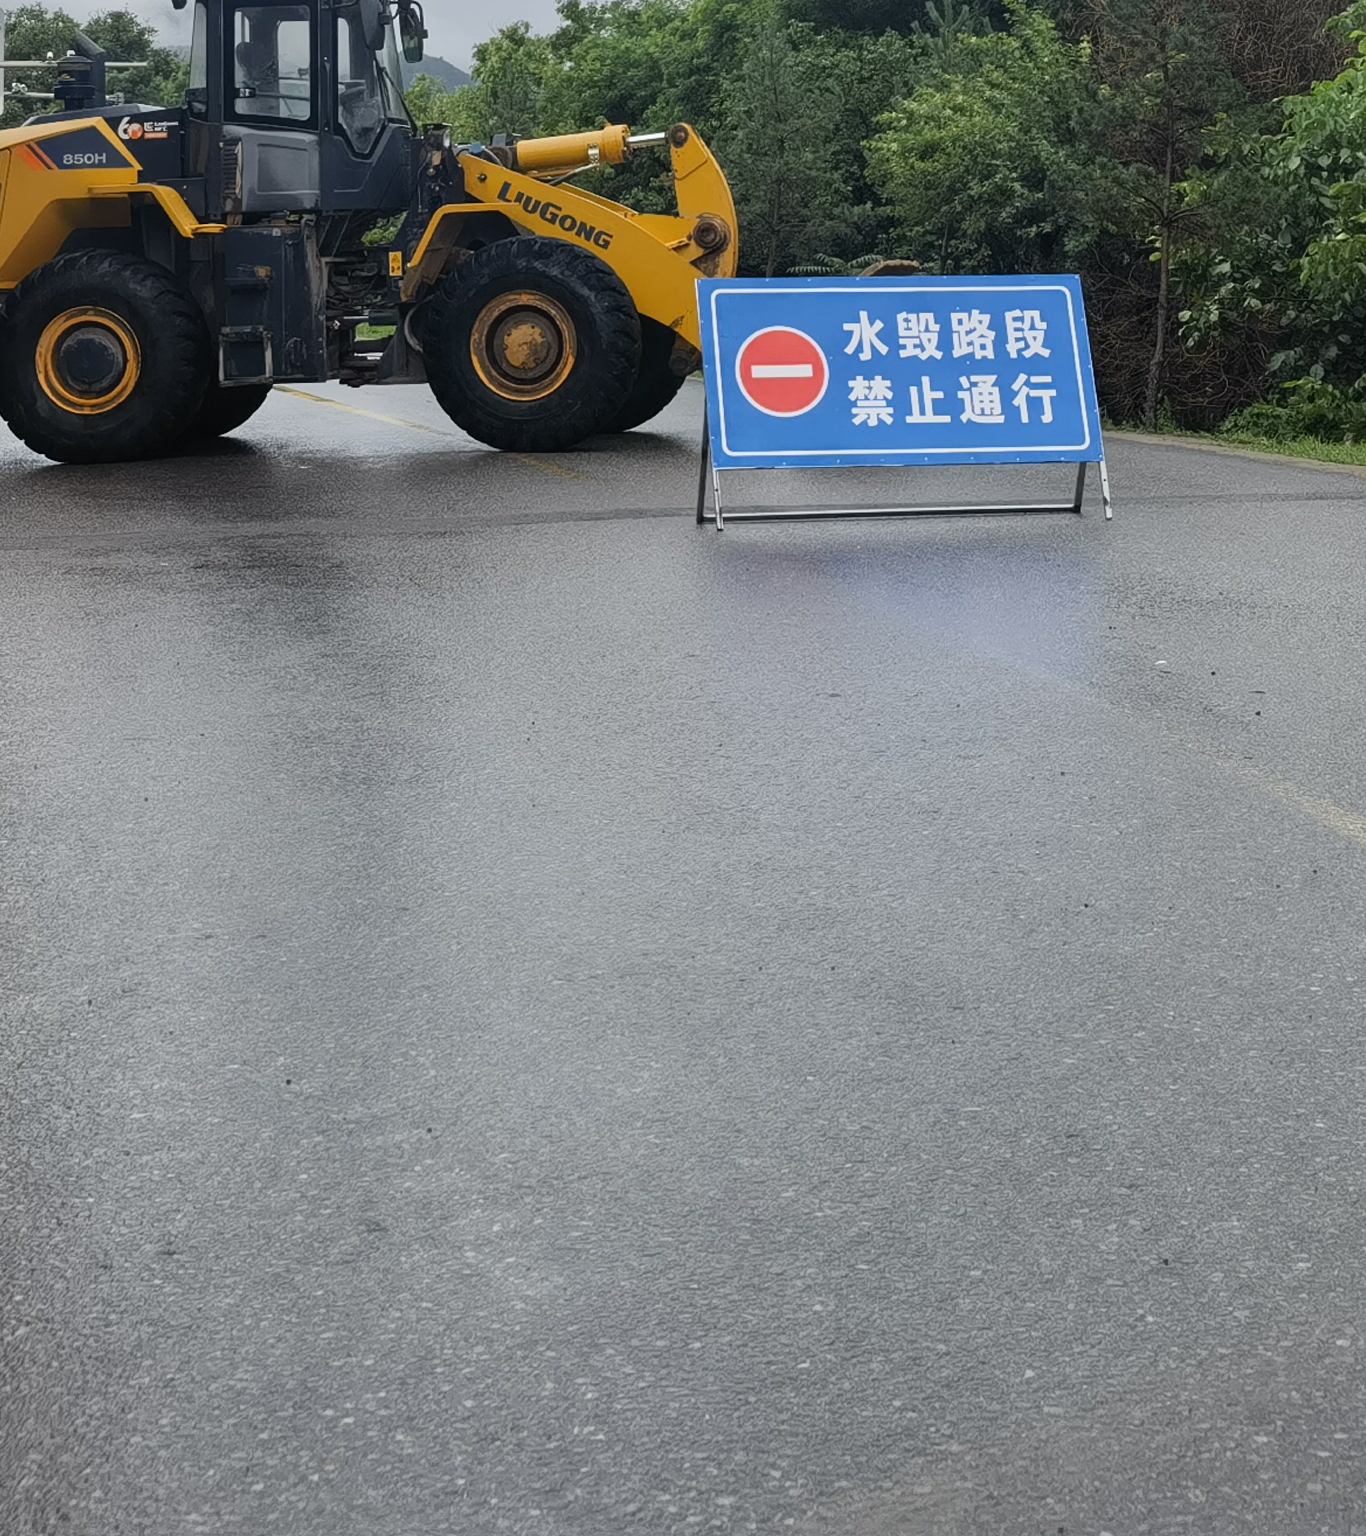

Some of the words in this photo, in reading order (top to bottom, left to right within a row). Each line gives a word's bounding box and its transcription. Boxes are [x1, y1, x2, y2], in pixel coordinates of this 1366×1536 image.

[62, 152, 107, 165] 850H
[842, 309, 1052, 361] 水毁路段
[848, 373, 1057, 427] 禁止通行
